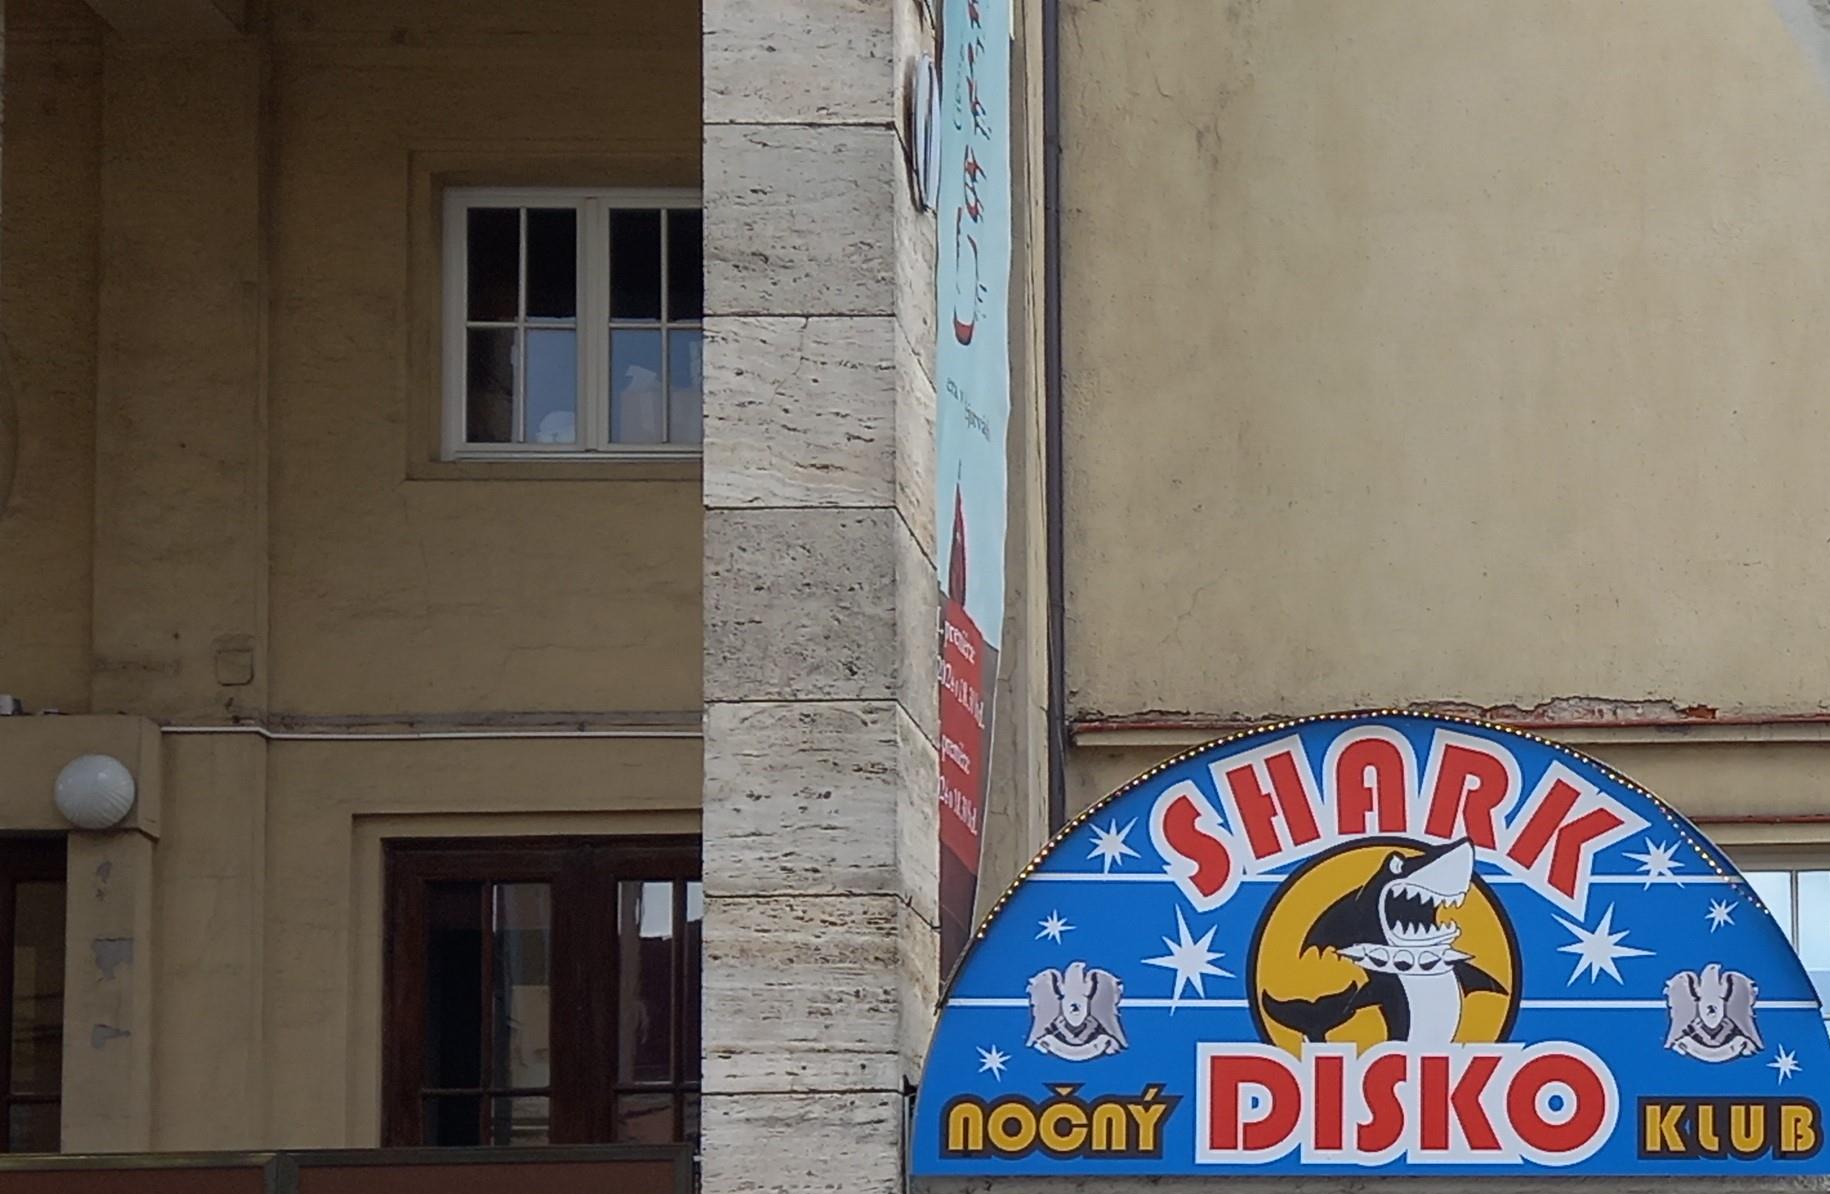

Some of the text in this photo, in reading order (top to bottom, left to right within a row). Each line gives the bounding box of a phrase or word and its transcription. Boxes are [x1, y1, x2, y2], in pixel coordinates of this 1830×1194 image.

[1160, 736, 1627, 901] SHARK
[945, 1082, 1166, 1153] NOČNÝ
[1203, 1051, 1606, 1155] DISKO
[1642, 1101, 1818, 1154] KLUB
